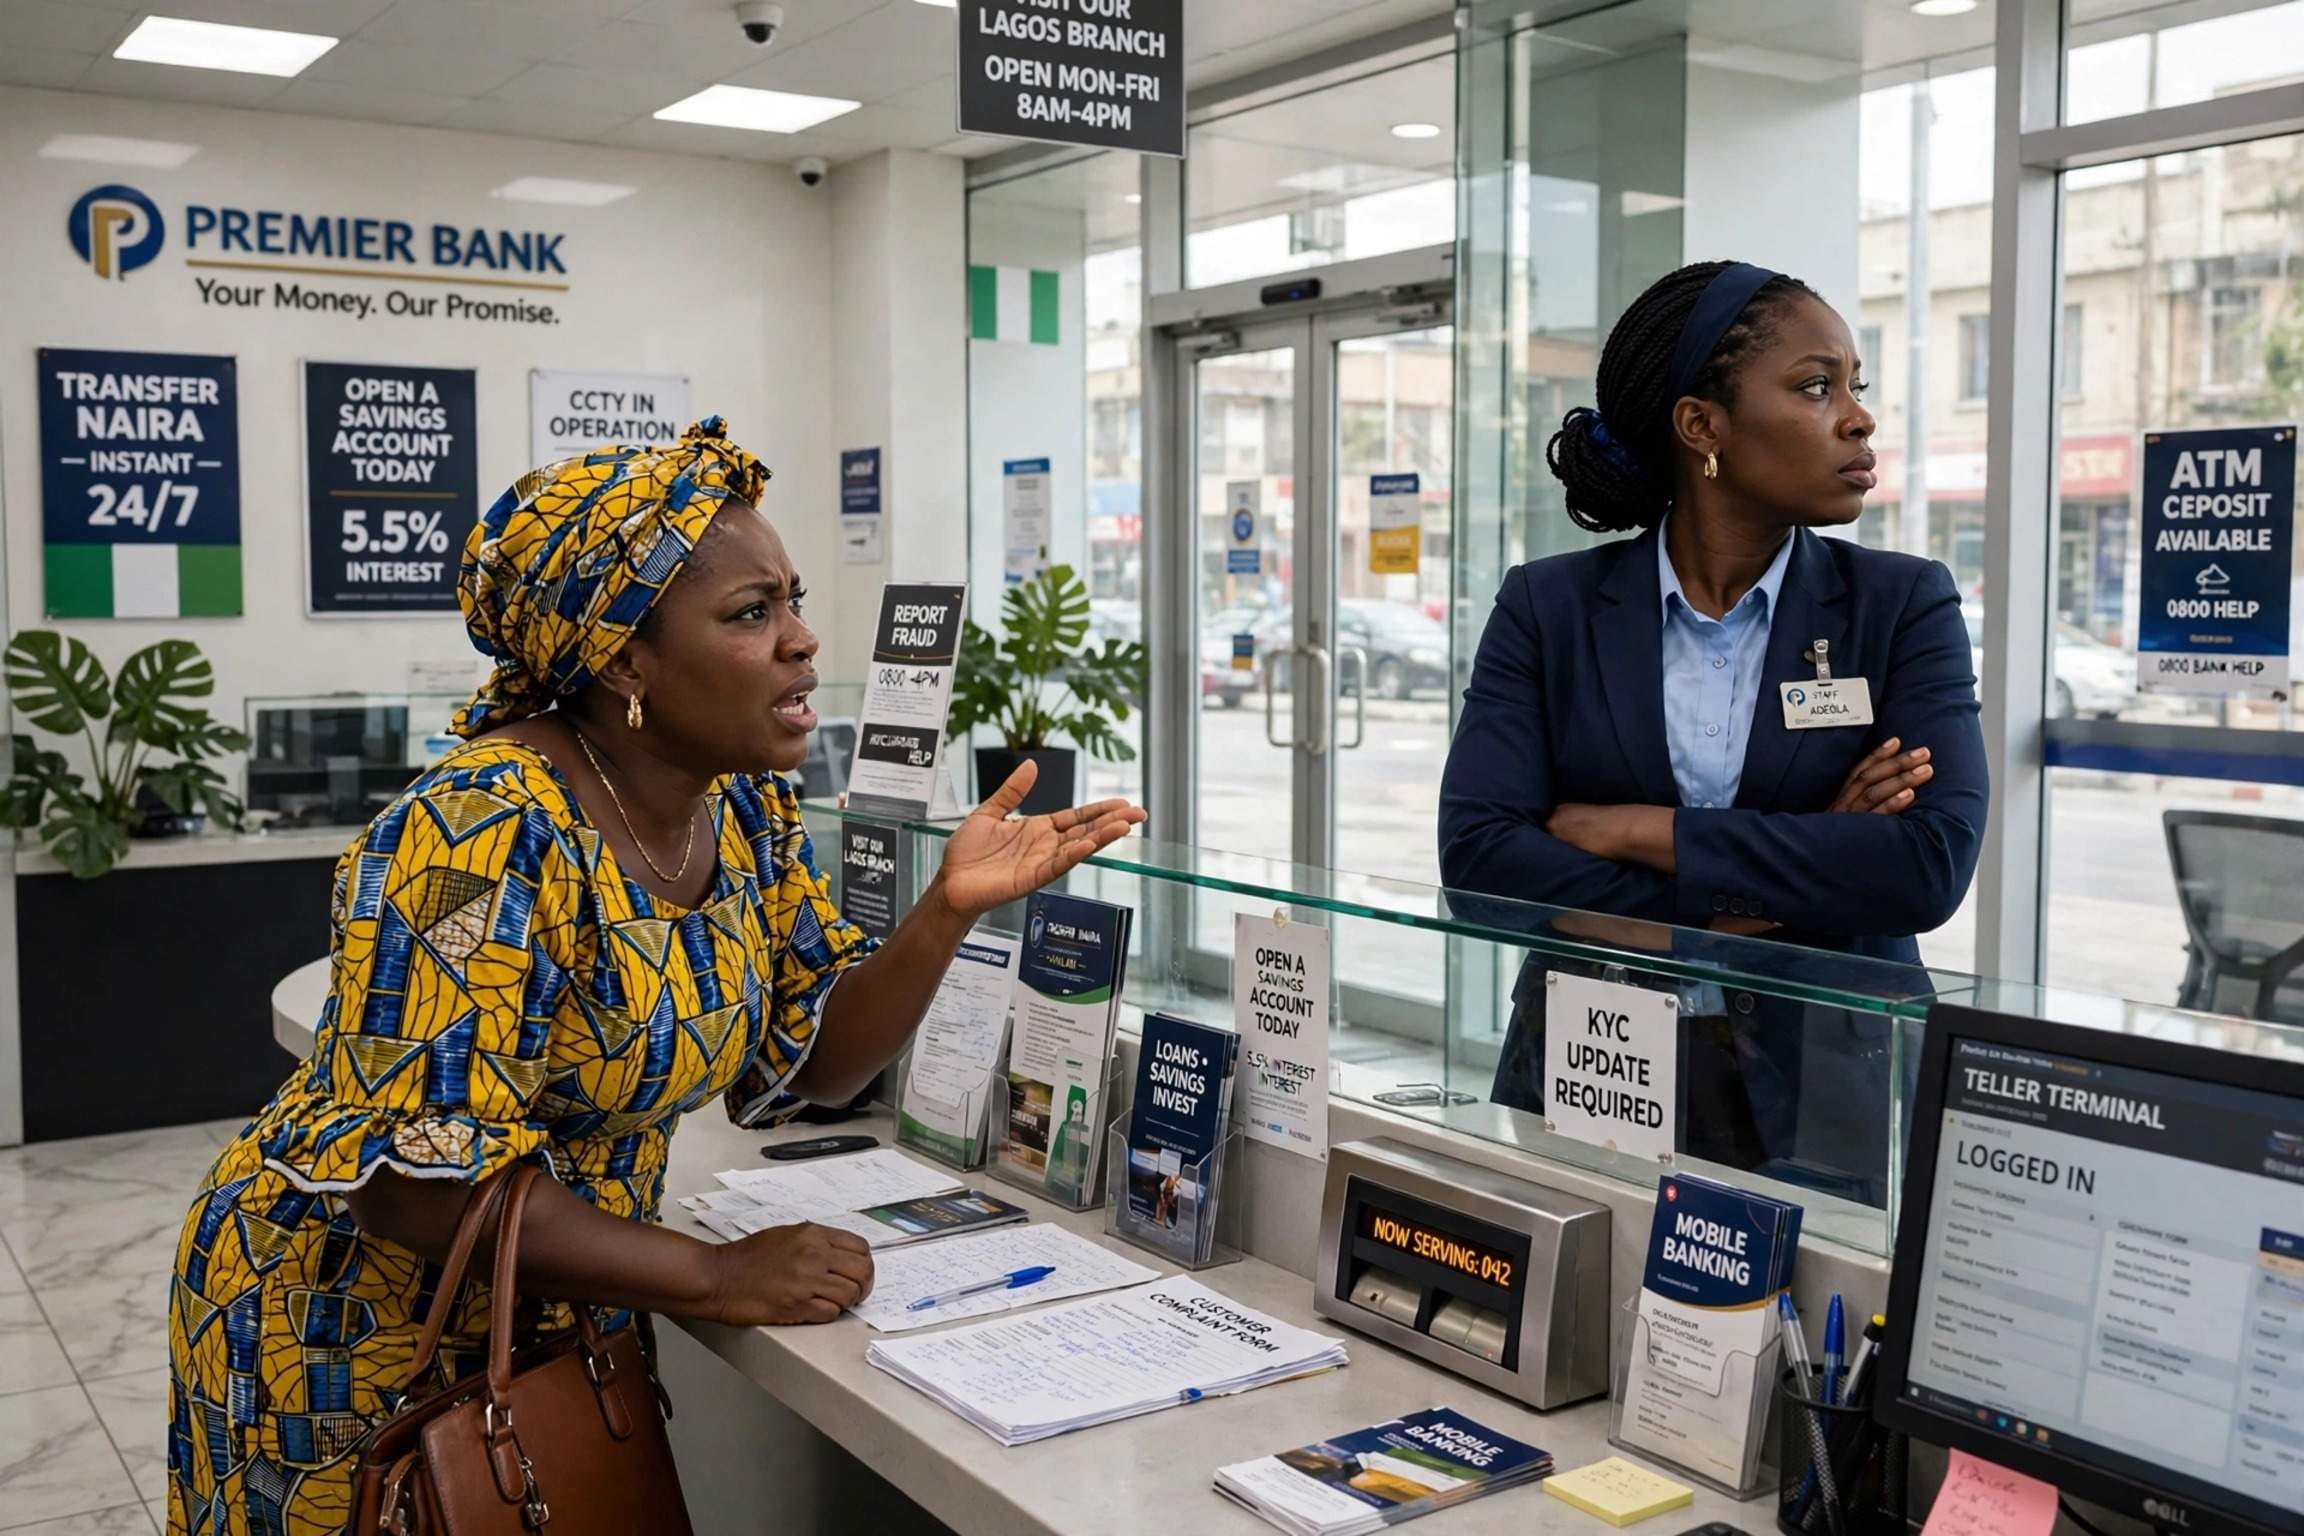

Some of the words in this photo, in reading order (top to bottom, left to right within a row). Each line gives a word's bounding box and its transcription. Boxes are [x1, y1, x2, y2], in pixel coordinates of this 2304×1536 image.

[1079, 0, 1131, 20] OUR
[979, 7, 1061, 43] LAGOS
[1067, 20, 1165, 58] BRANCH
[984, 54, 1052, 88] OPEN
[1058, 63, 1160, 102] MON-FRI
[1017, 92, 1132, 131] 8AM-4PM
[186, 204, 415, 264] PREMIER
[432, 228, 568, 274] BANK
[196, 277, 266, 309] Your
[274, 284, 378, 319] Money.
[386, 290, 439, 318] Our
[447, 294, 560, 325] Promise.
[56, 371, 219, 406] TRANSFER
[344, 377, 411, 403] OPEN
[418, 381, 439, 404] A
[633, 394, 654, 414] IN
[77, 405, 204, 442] NAIRA
[338, 405, 447, 431] SAVINGS
[549, 416, 675, 441] OPERATION
[332, 431, 453, 457] ACCOUNT
[90, 451, 192, 475] INSTANT
[351, 457, 436, 484] TODAY
[2170, 447, 2263, 489] ATM
[87, 480, 199, 533] 24/7
[340, 510, 449, 555] 5.5%
[2155, 529, 2272, 552] AVAILABLE
[346, 561, 444, 583] INTEREST
[893, 604, 948, 625] REPORT
[2166, 599, 2211, 619] 0800
[2214, 600, 2260, 619] HELP
[891, 627, 937, 648] FRAUD
[2232, 661, 2264, 676] HELP
[1810, 704, 1850, 716] ADEOLA
[1255, 947, 1292, 975] OPEN
[1295, 955, 1306, 976] A
[1257, 969, 1304, 992] SAVINGS
[1249, 987, 1314, 1019] ACCOUNT
[1255, 1012, 1300, 1040] TODAY
[1588, 1006, 1630, 1043] KYC
[1155, 1040, 1200, 1069] LOANS
[1567, 1041, 1650, 1087] UPDATE
[1149, 1063, 1205, 1095] SAVINGS
[1152, 1089, 1198, 1117] INVEST
[1555, 1077, 1664, 1129] REQUIRED
[1964, 1067, 2041, 1104] TELLER
[2047, 1083, 2166, 1131] TERMINAL
[1957, 1140, 2060, 1185] LOGGED
[2066, 1165, 2096, 1195] IN
[1675, 1212, 1748, 1256] MOBILE
[1374, 1216, 1411, 1248] NOW
[1412, 1230, 1479, 1275] SERVING:
[1480, 1255, 1512, 1287] 042
[1662, 1236, 1751, 1287] BANKING
[1149, 1293, 1238, 1338] COMPLAINT
[1232, 1327, 1281, 1353] FORM
[1189, 1296, 1272, 1336] CUSTOMER
[1404, 1425, 1494, 1467] BANKING
[1428, 1421, 1505, 1458] MOBILE
